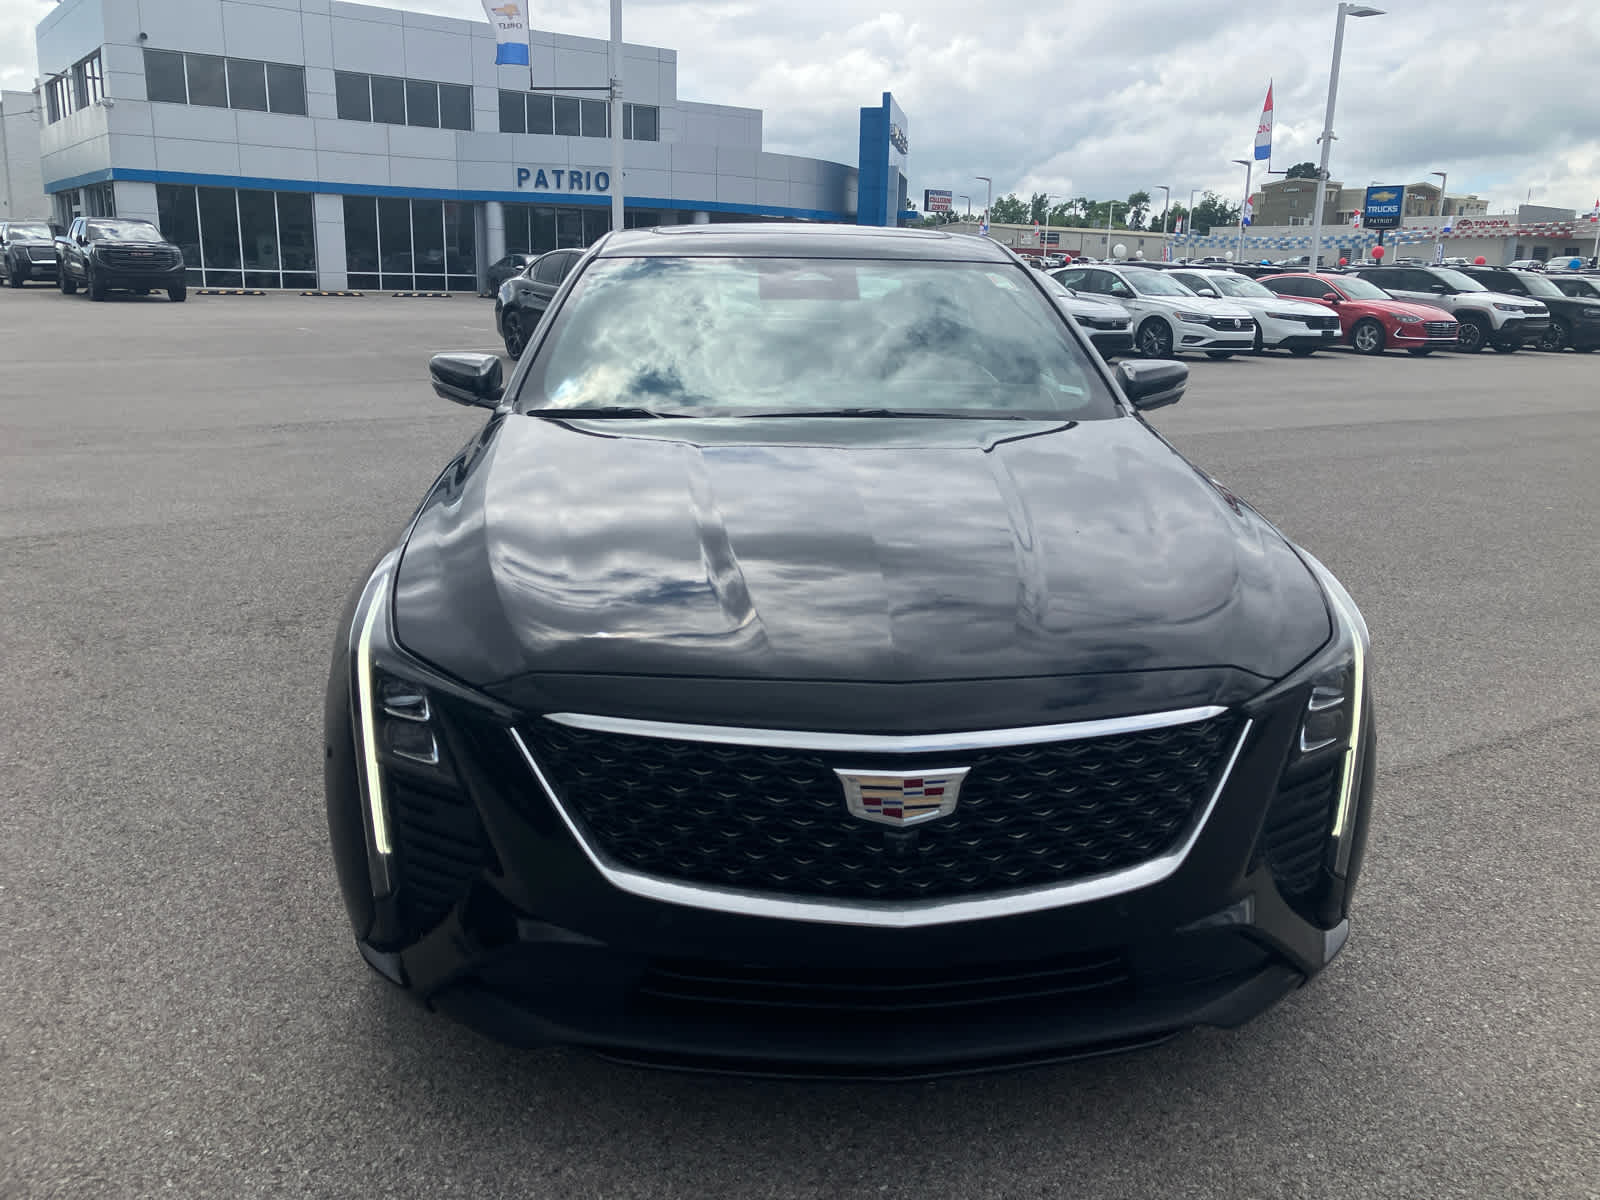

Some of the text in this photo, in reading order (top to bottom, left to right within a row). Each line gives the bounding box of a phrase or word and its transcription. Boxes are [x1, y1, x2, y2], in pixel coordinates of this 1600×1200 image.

[516, 167, 625, 192] PATRIO
[1367, 205, 1399, 213] TRUCKS
[1473, 219, 1509, 229] TOYOTA
